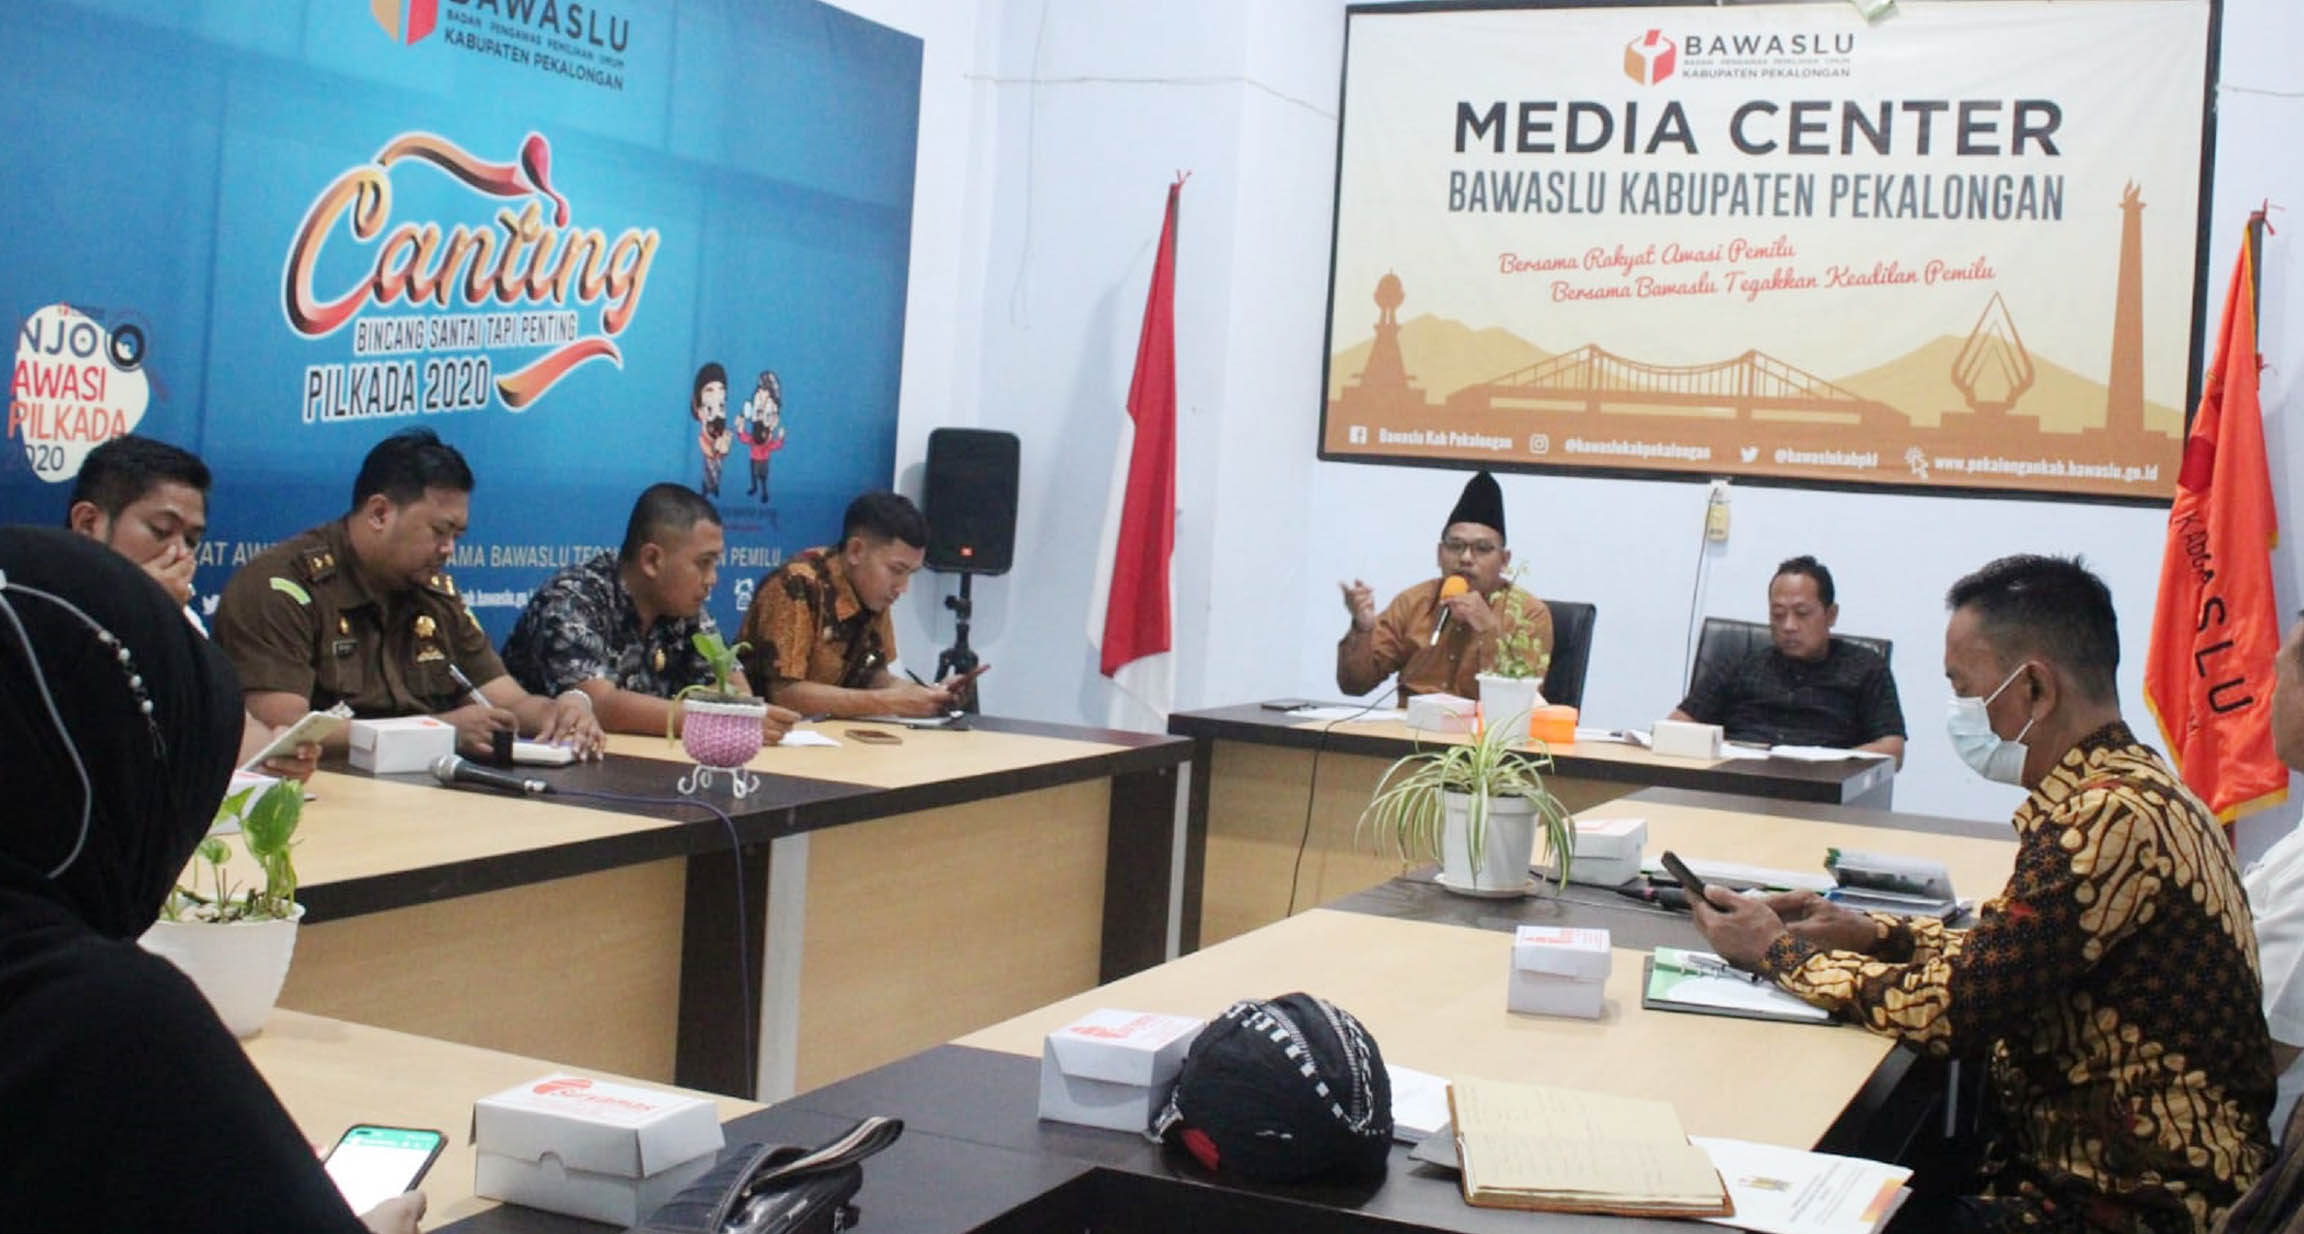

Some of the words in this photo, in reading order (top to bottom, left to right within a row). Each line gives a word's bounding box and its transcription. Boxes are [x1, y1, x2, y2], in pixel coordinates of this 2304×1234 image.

[448, 0, 629, 51] WASLU
[1684, 33, 1855, 56] BAWASLU
[444, 28, 529, 65] KABUPATEN
[533, 52, 623, 91] PEKALONGAN
[1683, 68, 1757, 78] KABUPATEN
[1761, 67, 1850, 78] PEKALONGAN
[1454, 100, 1699, 154] MEDIA
[1729, 100, 2063, 156] CENTER
[1449, 170, 1605, 214] BAWASLU
[1620, 172, 1815, 217] KABUPATEN
[1829, 174, 2064, 220] PEKALONGAN
[284, 160, 660, 337] Canting
[1499, 252, 1578, 274] Bersama
[1583, 245, 1656, 275] Rakyat
[1661, 243, 1723, 265] Awasi
[1728, 235, 1797, 262] Pemilu
[1551, 281, 1631, 302] Bersama
[1635, 271, 1718, 299] Bawaslu
[1724, 268, 1817, 302] Tegakkan
[1825, 261, 1919, 288] Keadilan
[1924, 256, 1997, 285] Pemilu
[357, 320, 425, 352] BINCANG
[429, 317, 482, 349] SANTAI
[487, 315, 516, 345] TAPI
[521, 314, 577, 343] PENTING
[11, 360, 107, 402] AWASI
[307, 363, 416, 419] PILKADA
[426, 360, 489, 409] 2020
[7, 402, 127, 442] PILKADA
[490, 545, 569, 567] BAWASLU
[730, 547, 782, 568] PEMILU
